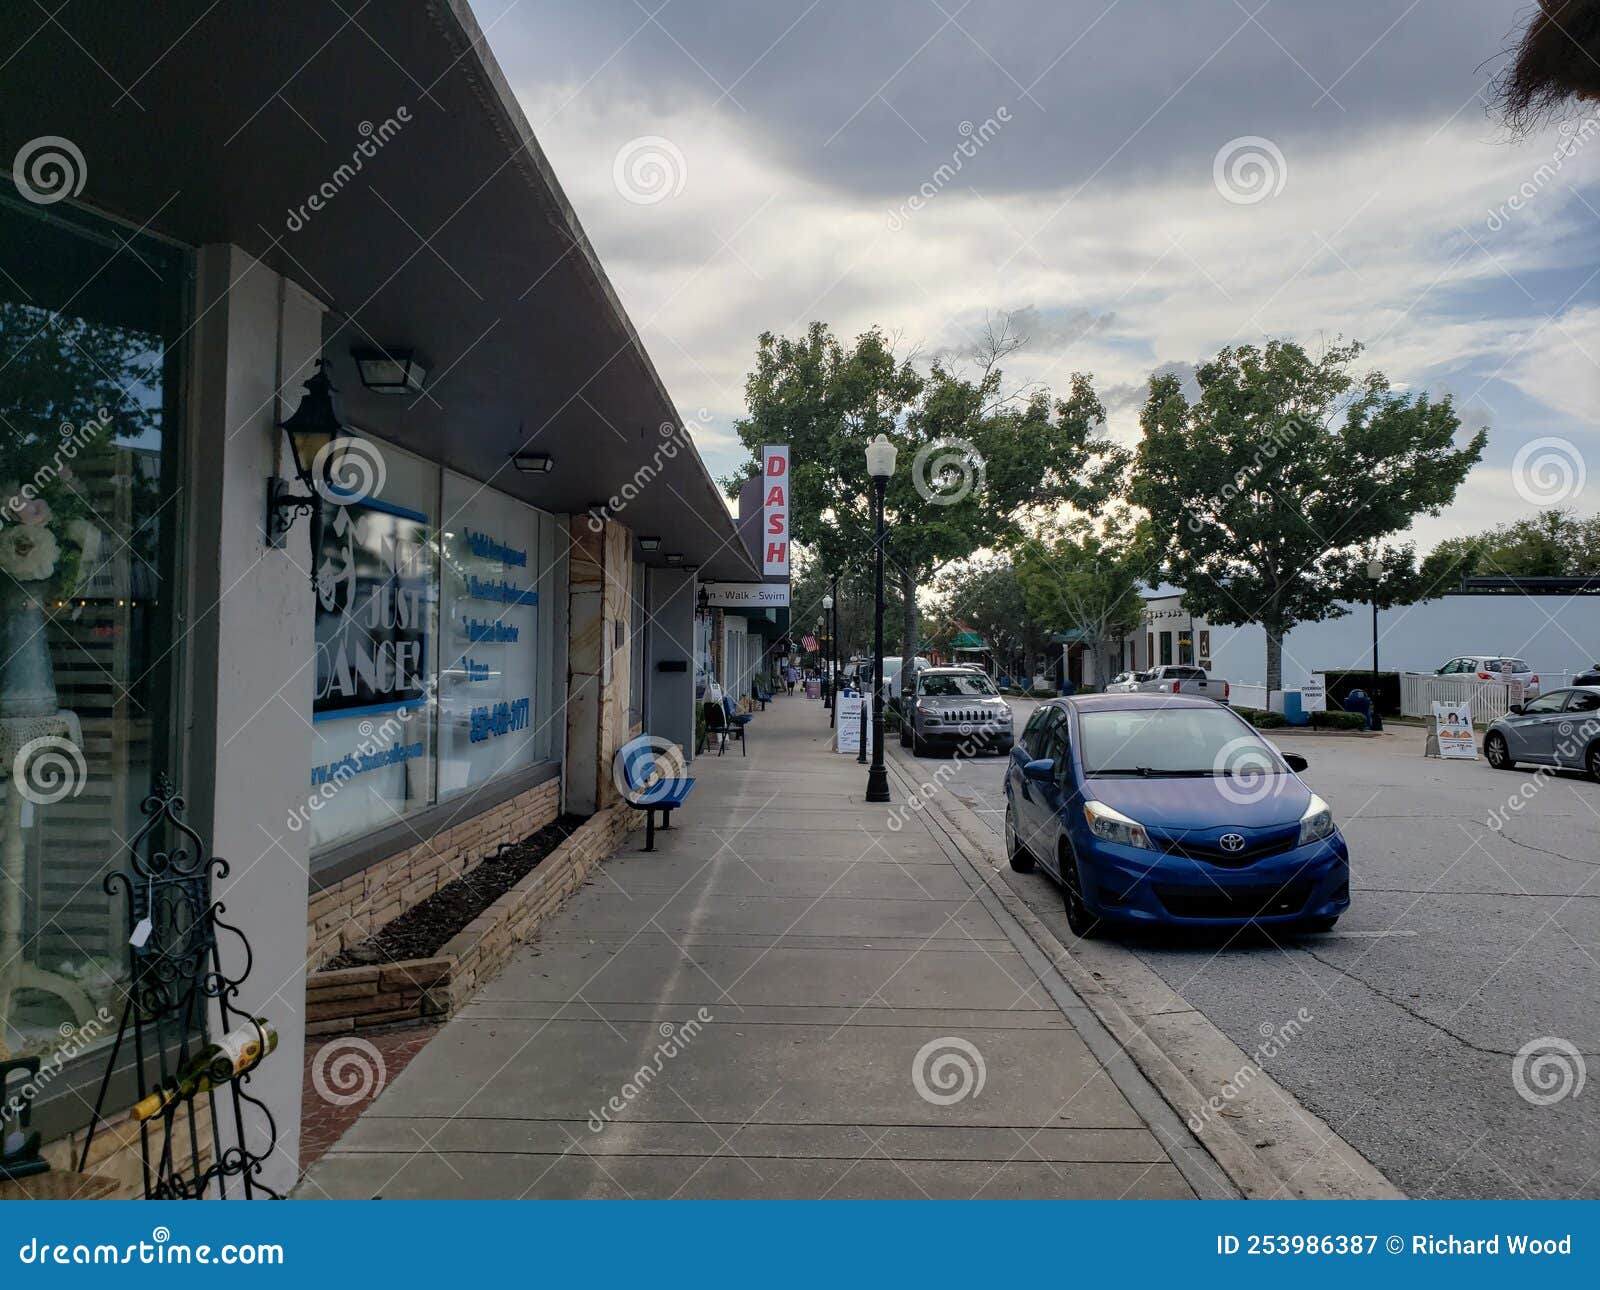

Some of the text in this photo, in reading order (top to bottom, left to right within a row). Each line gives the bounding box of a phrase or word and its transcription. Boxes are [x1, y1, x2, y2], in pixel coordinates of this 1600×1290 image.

[766, 456, 786, 563] DASH
[365, 584, 420, 629] JUST
[725, 591, 750, 600] Walk
[758, 591, 785, 600] Swim
[314, 640, 420, 699] DANCE!
